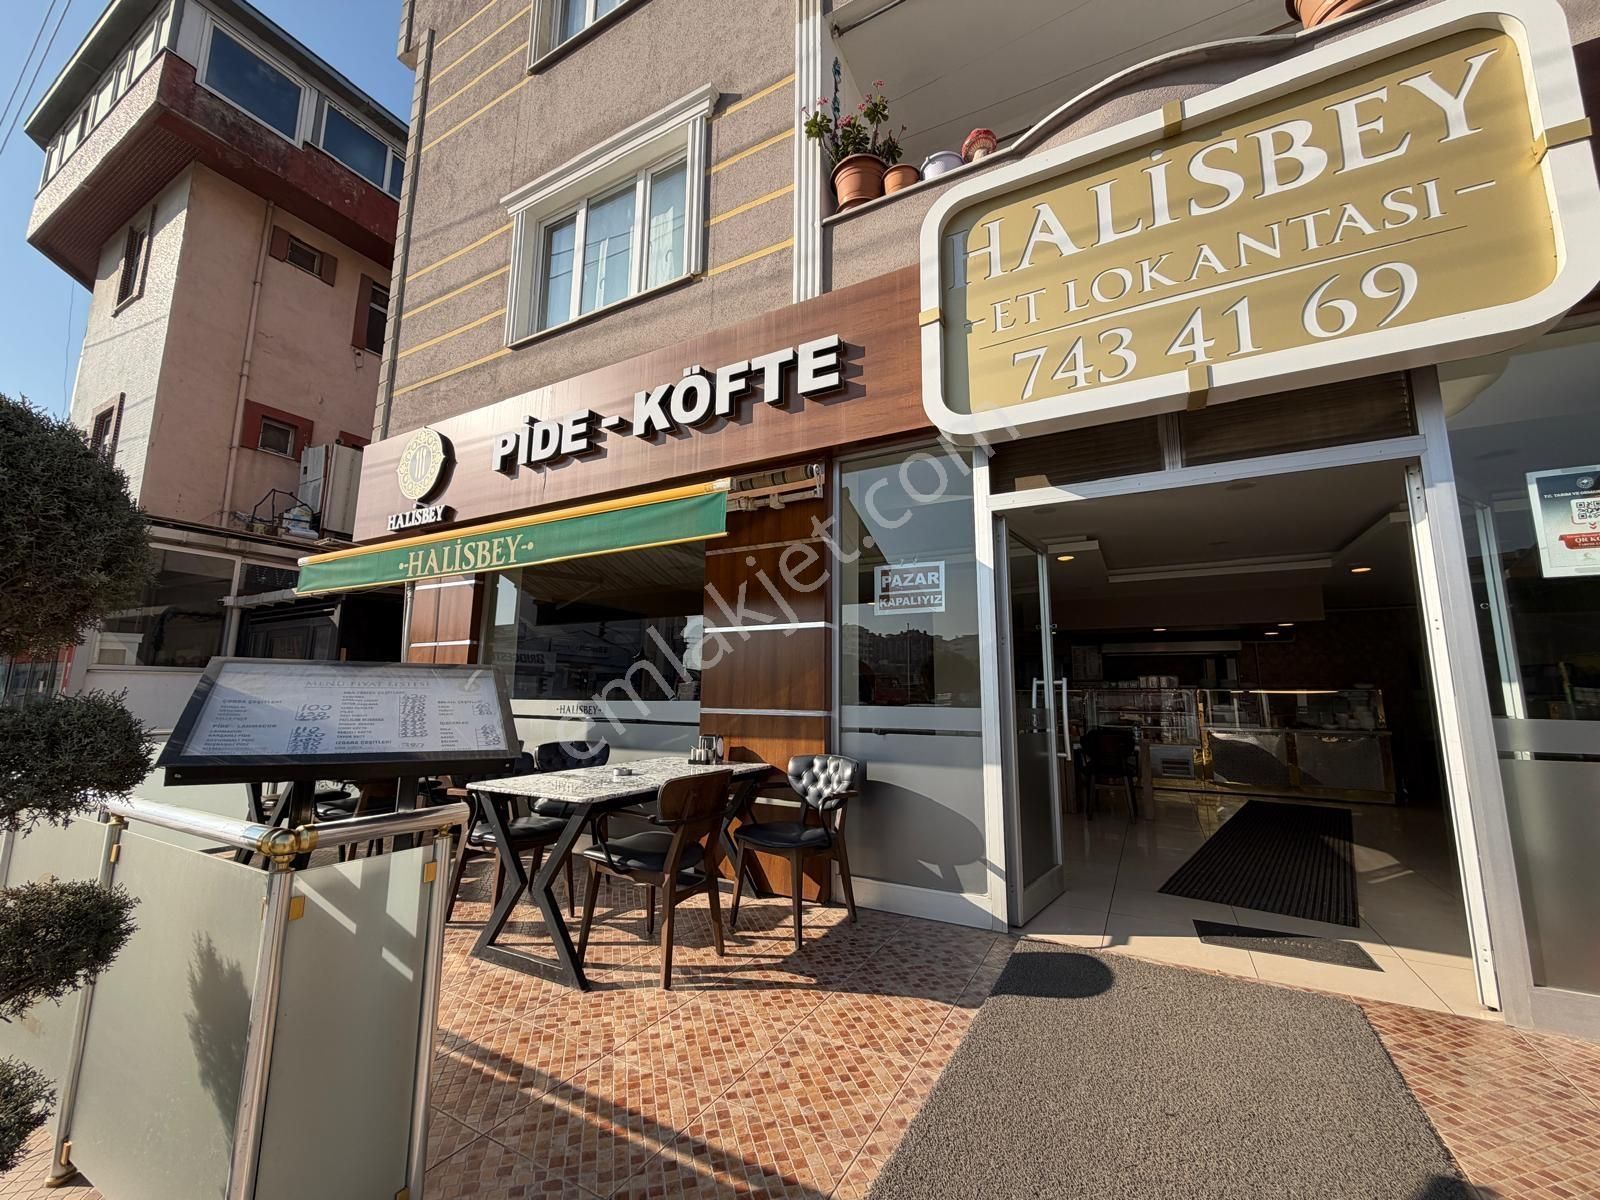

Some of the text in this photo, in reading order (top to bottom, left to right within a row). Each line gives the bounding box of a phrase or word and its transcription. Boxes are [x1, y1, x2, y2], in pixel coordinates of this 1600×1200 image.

[948, 48, 1500, 291] HALİSBEY
[991, 179, 1448, 333] ET LOKANTASI
[1012, 261, 1418, 401] 743 41 69
[491, 409, 593, 472] PİDE
[634, 334, 842, 438] KÖFTE
[387, 503, 445, 531] HALİSBEY
[407, 534, 521, 577] HALİSBEY
[880, 595, 942, 608] KAPALIYIZ
[881, 571, 940, 588] PAZAR
